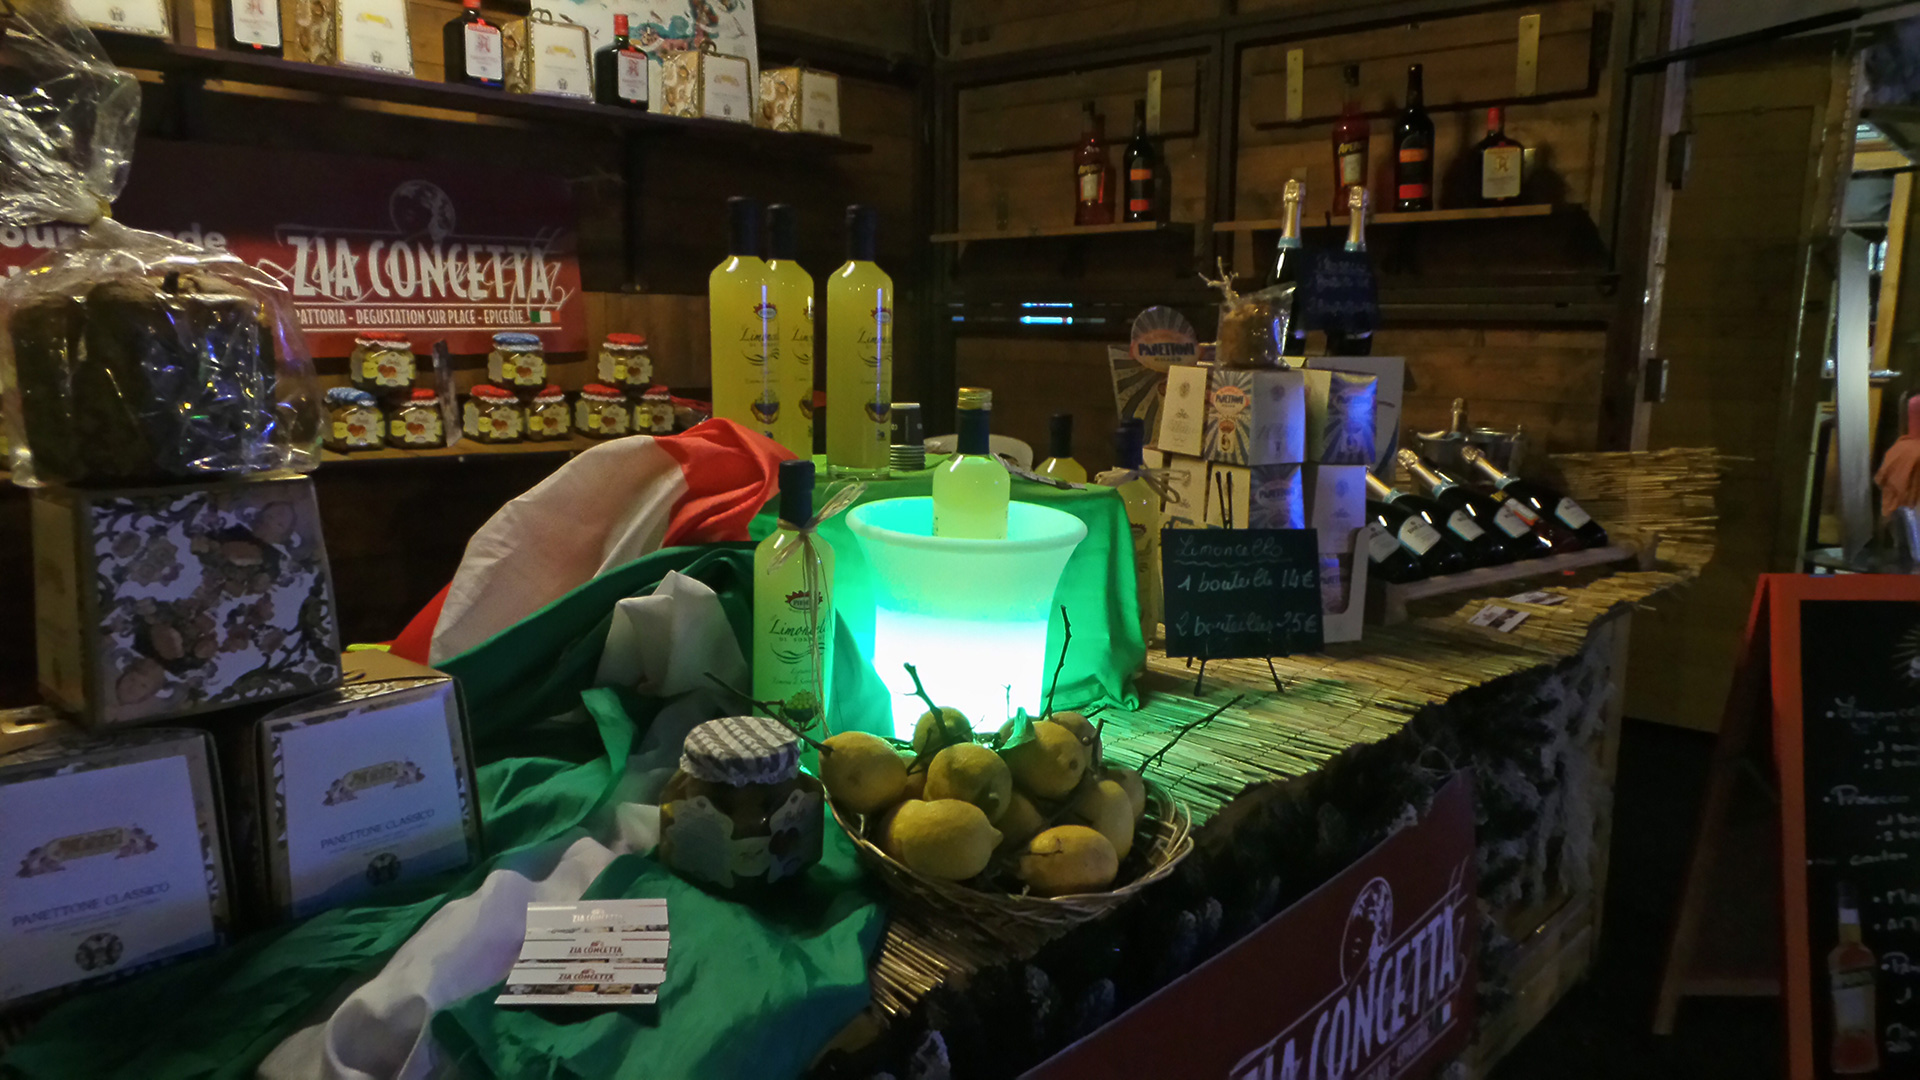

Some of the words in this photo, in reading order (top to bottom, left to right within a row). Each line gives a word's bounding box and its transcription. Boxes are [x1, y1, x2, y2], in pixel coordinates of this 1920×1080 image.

[287, 236, 361, 299] ZIA
[367, 239, 552, 300] CONCETTA
[356, 309, 425, 326] DEGUSTATION
[425, 309, 446, 326] SUR
[447, 309, 476, 326] PLACE
[484, 309, 523, 326] EPICERIE
[1176, 534, 1284, 557] Limoncello
[1177, 574, 1191, 591] 1
[1281, 568, 1315, 589] 14€
[321, 824, 381, 849] PANETTONE
[385, 809, 435, 830] CLASSICO
[12, 898, 99, 928] PANETTONE
[104, 882, 170, 906] CLASSICO
[569, 946, 582, 954] ZIA
[559, 973, 572, 981] ZIA
[1309, 903, 1457, 1080] CONCETTA
